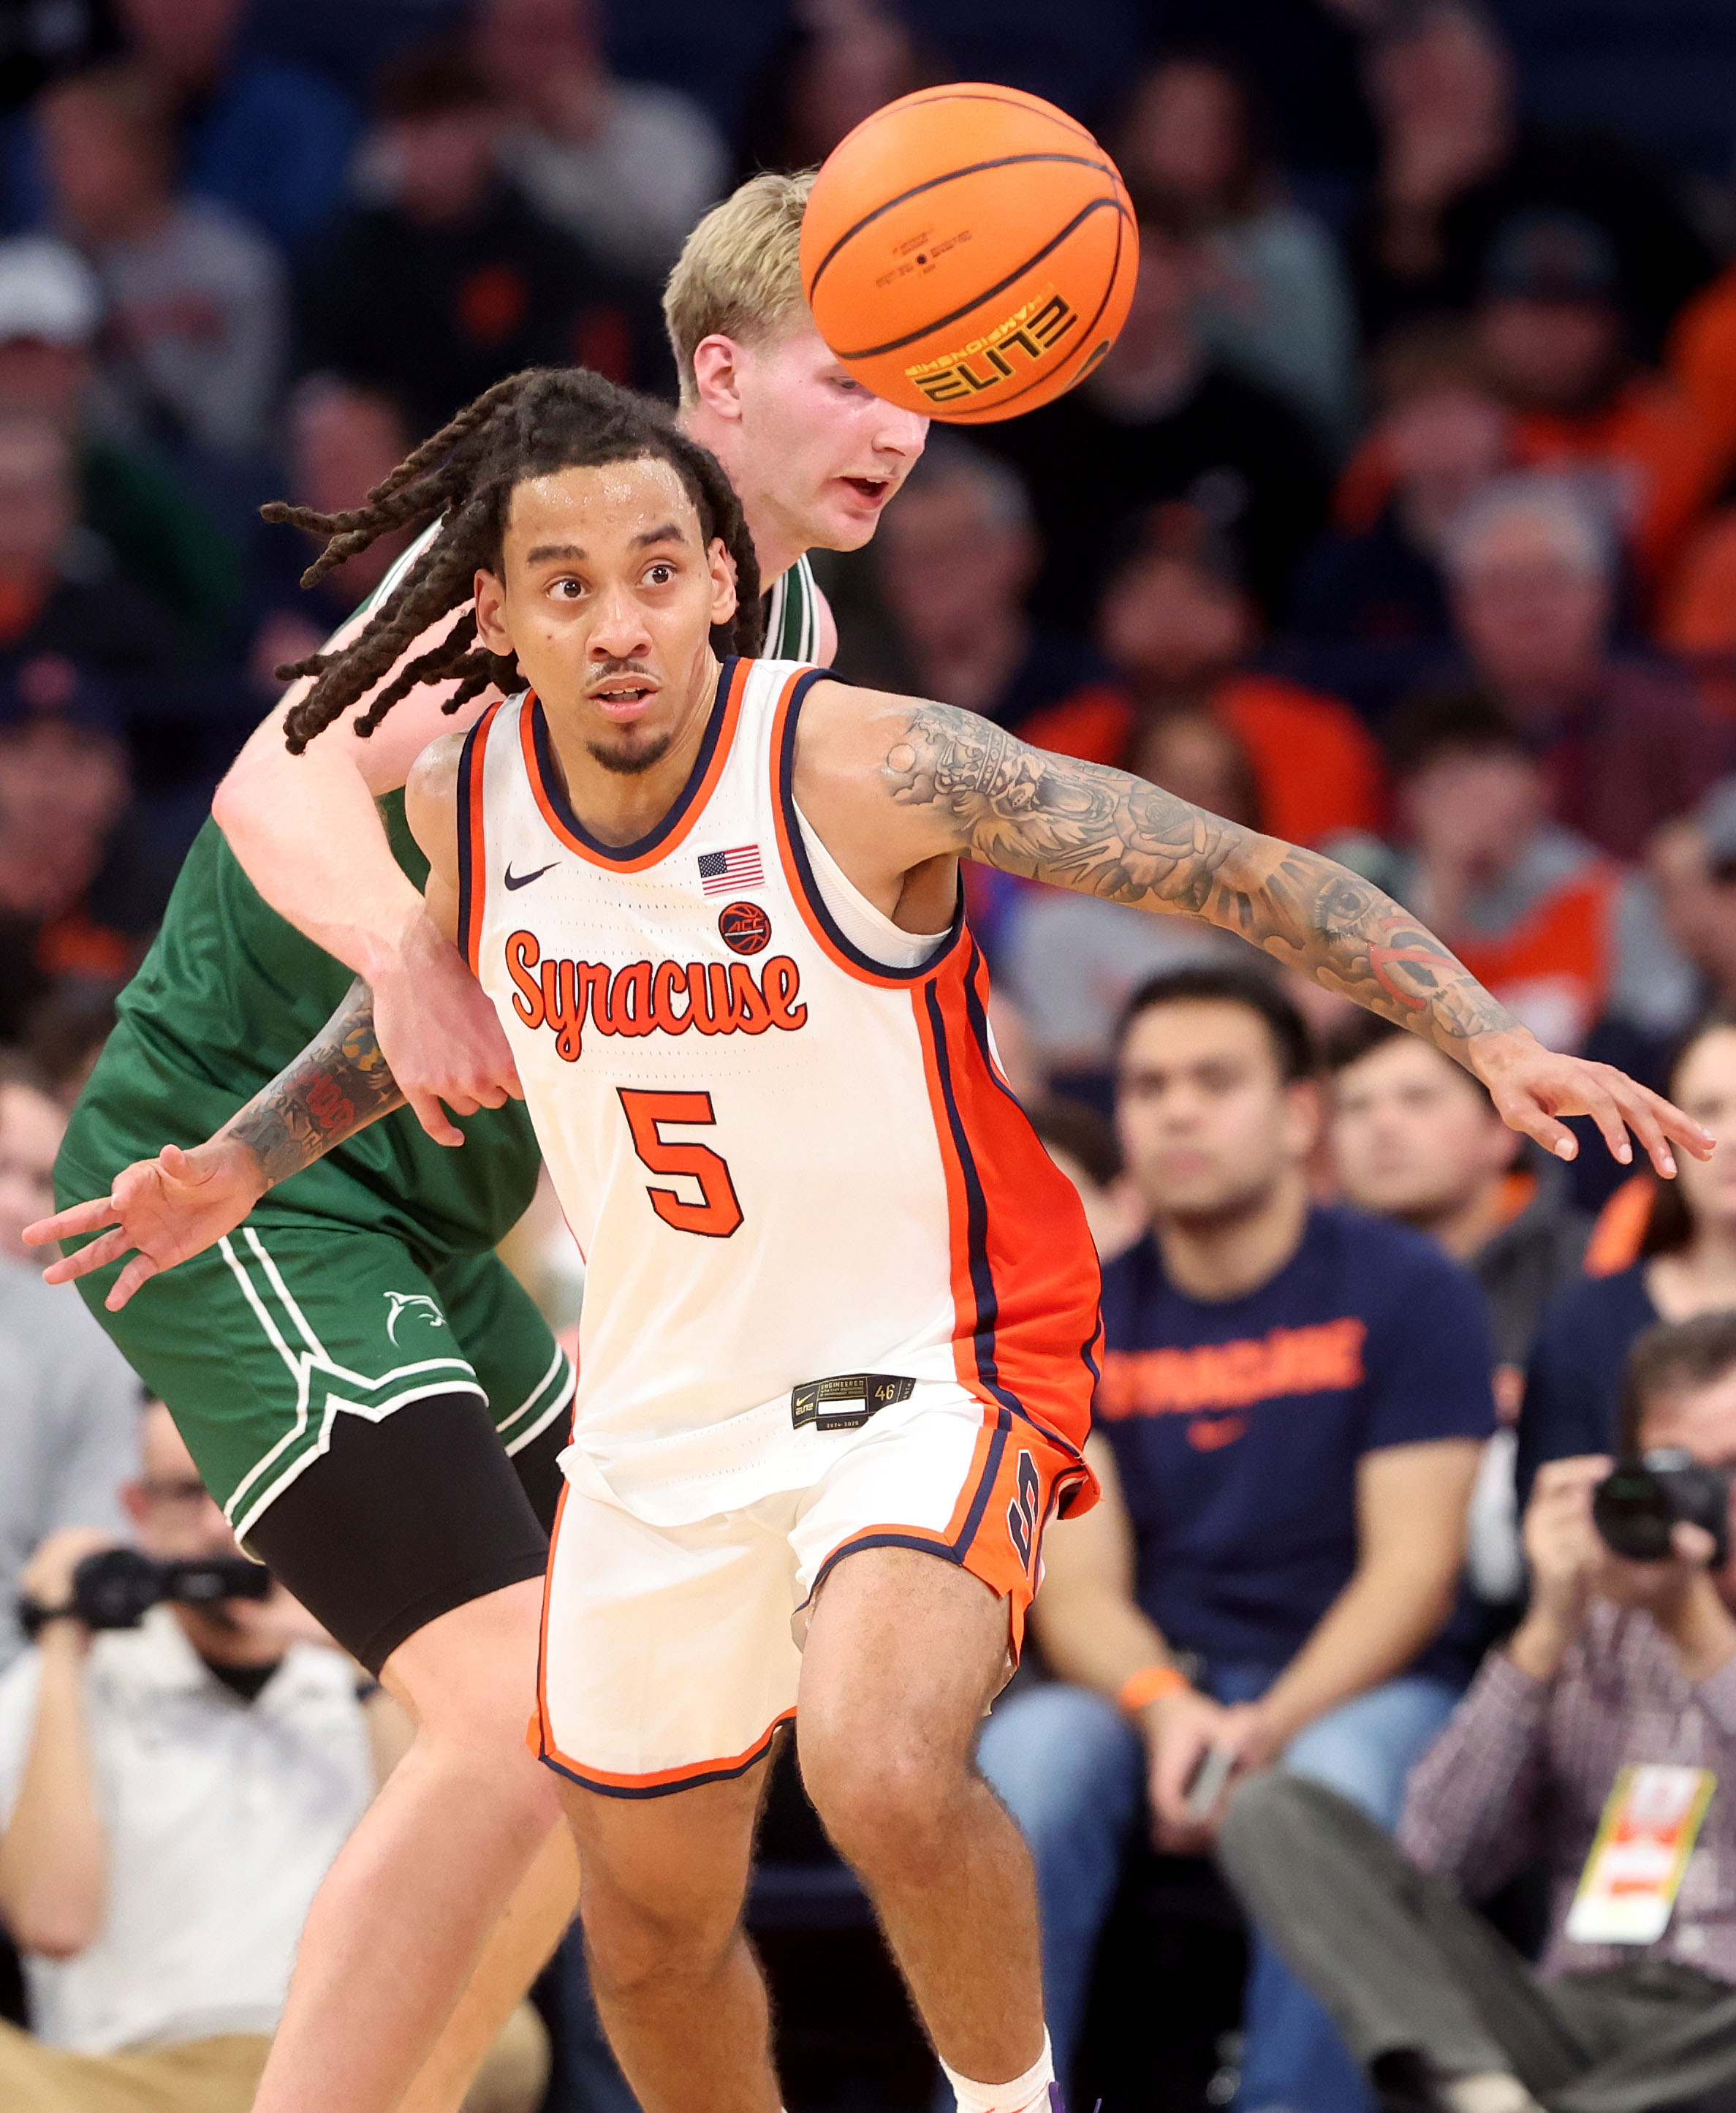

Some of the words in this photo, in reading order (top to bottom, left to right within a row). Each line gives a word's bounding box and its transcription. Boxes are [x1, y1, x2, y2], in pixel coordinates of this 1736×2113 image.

[905, 282, 1054, 376] HAMPIONSHIP
[911, 294, 1079, 404] ELITE
[728, 918, 765, 932] ACC
[504, 929, 808, 1062] Syracuse
[615, 1087, 745, 1238] 5
[821, 1380, 864, 1390] ENGINEERED
[875, 1383, 895, 1401] 46
